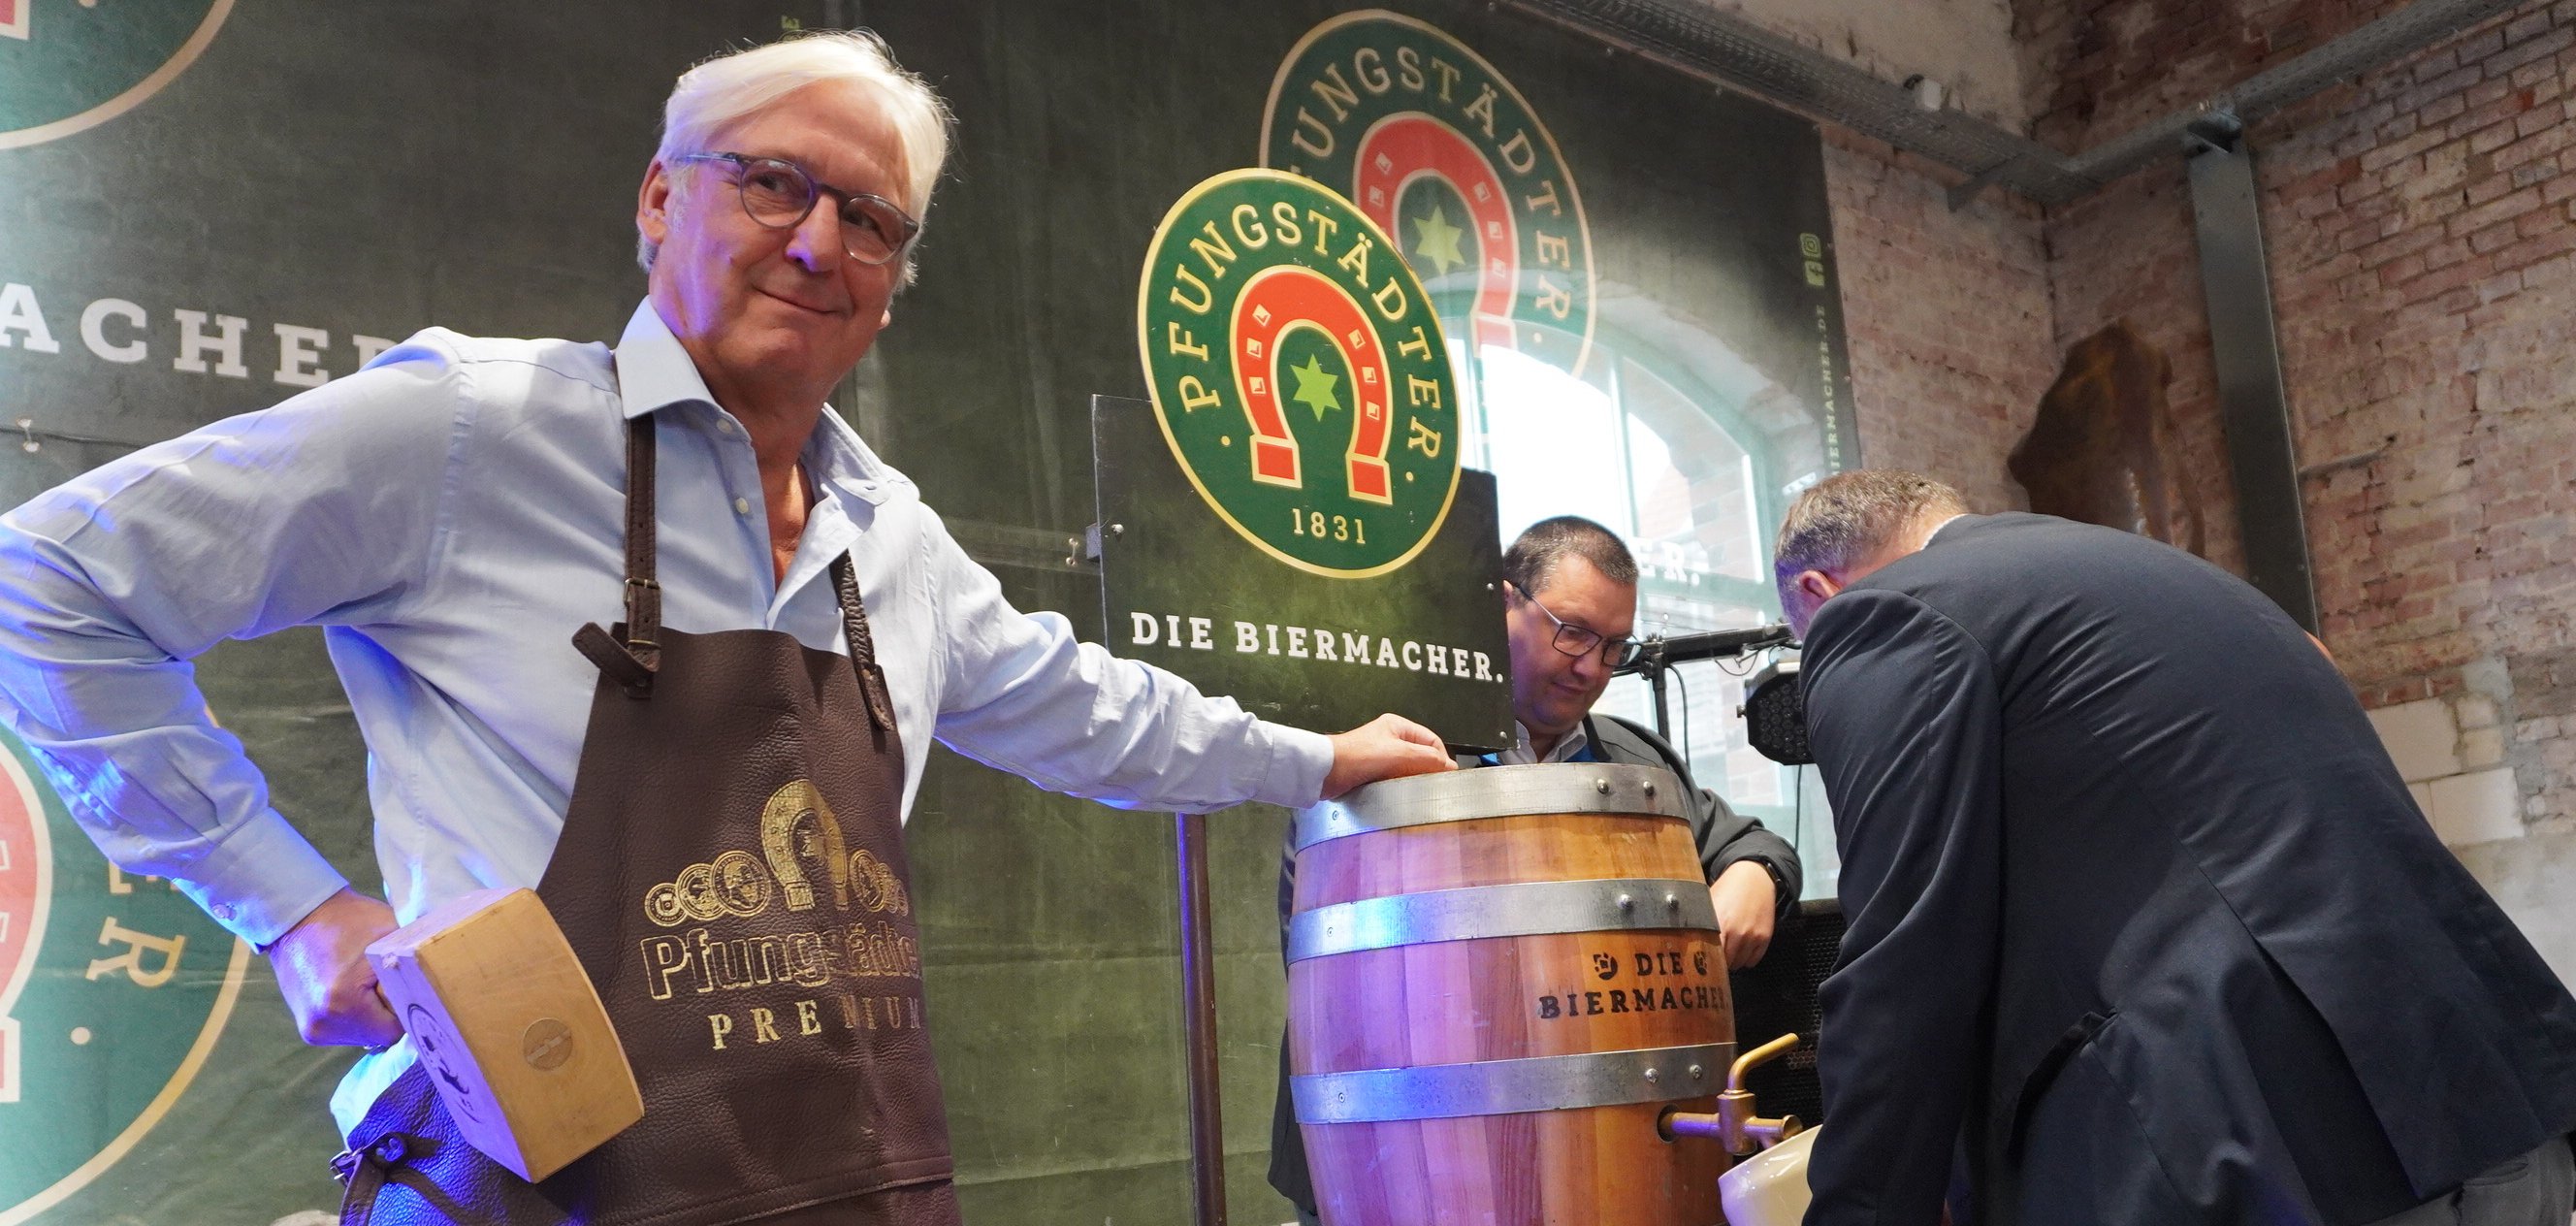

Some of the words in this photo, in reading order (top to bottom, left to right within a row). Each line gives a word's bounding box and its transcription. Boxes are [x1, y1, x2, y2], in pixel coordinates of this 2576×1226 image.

[1291, 47, 1571, 321] UNGSTÄDTER
[1169, 201, 1441, 460] PFUNGSTÄDTER
[1816, 304, 1841, 476] IERMACHER.DE
[1292, 507, 1366, 544] 1831
[1130, 611, 1213, 650] DIE
[1234, 620, 1504, 683] BIERMACHER.
[1634, 952, 1684, 978] DIE
